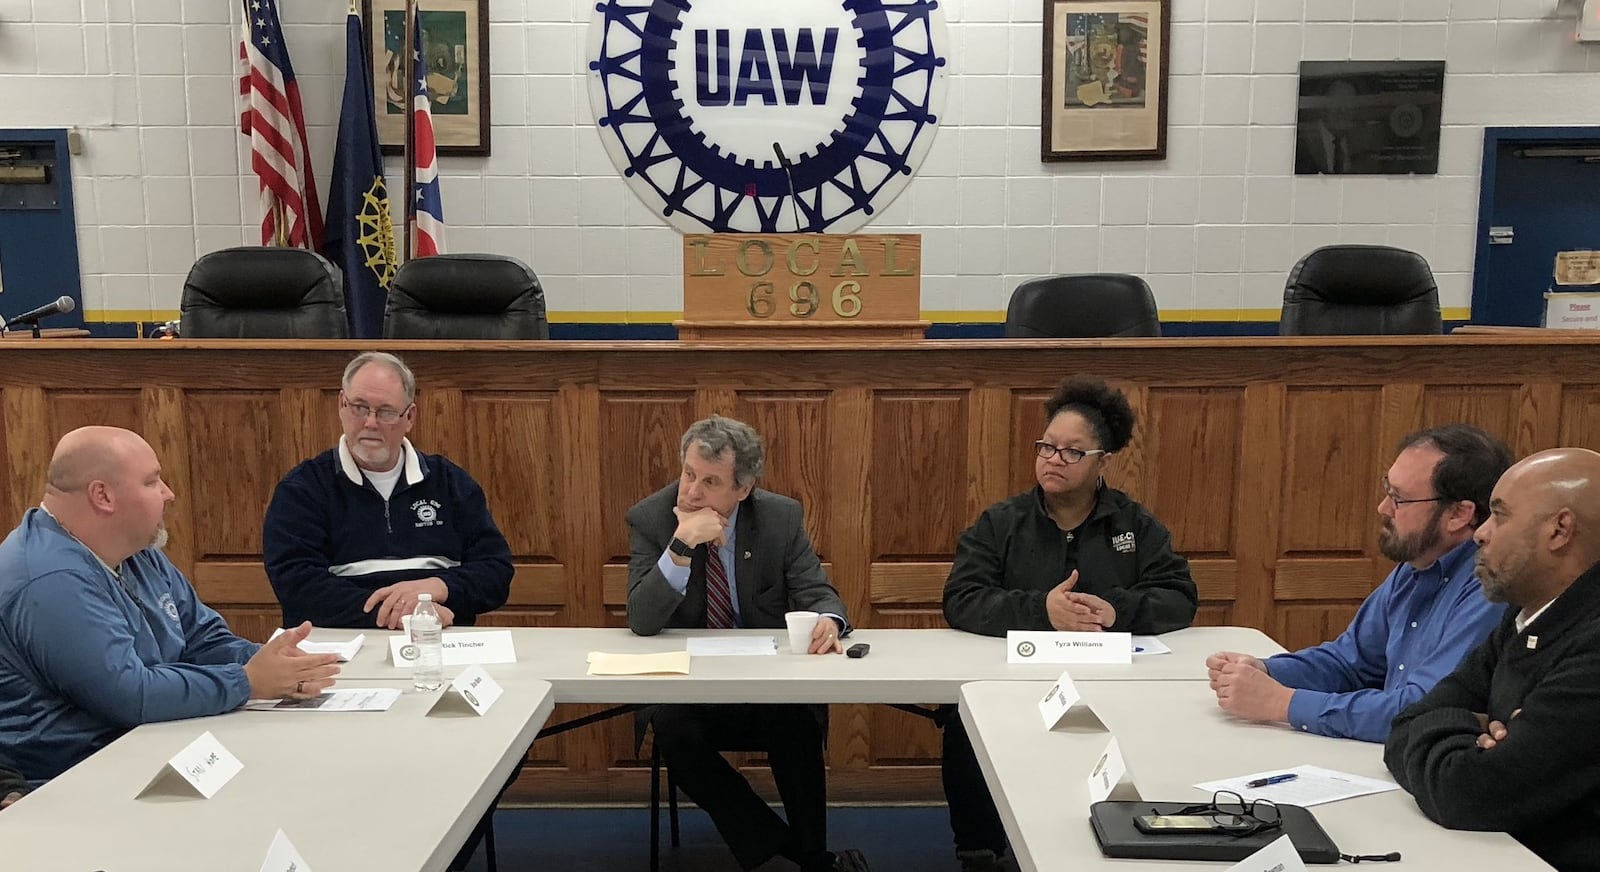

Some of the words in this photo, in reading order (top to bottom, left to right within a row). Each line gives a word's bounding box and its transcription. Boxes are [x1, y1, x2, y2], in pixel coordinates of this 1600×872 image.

[694, 27, 840, 107] UAW
[689, 238, 917, 278] LOCAL
[745, 280, 864, 319] 696
[1569, 303, 1592, 312] Please
[1054, 640, 1071, 648] Tyra
[1072, 640, 1103, 648] Williams
